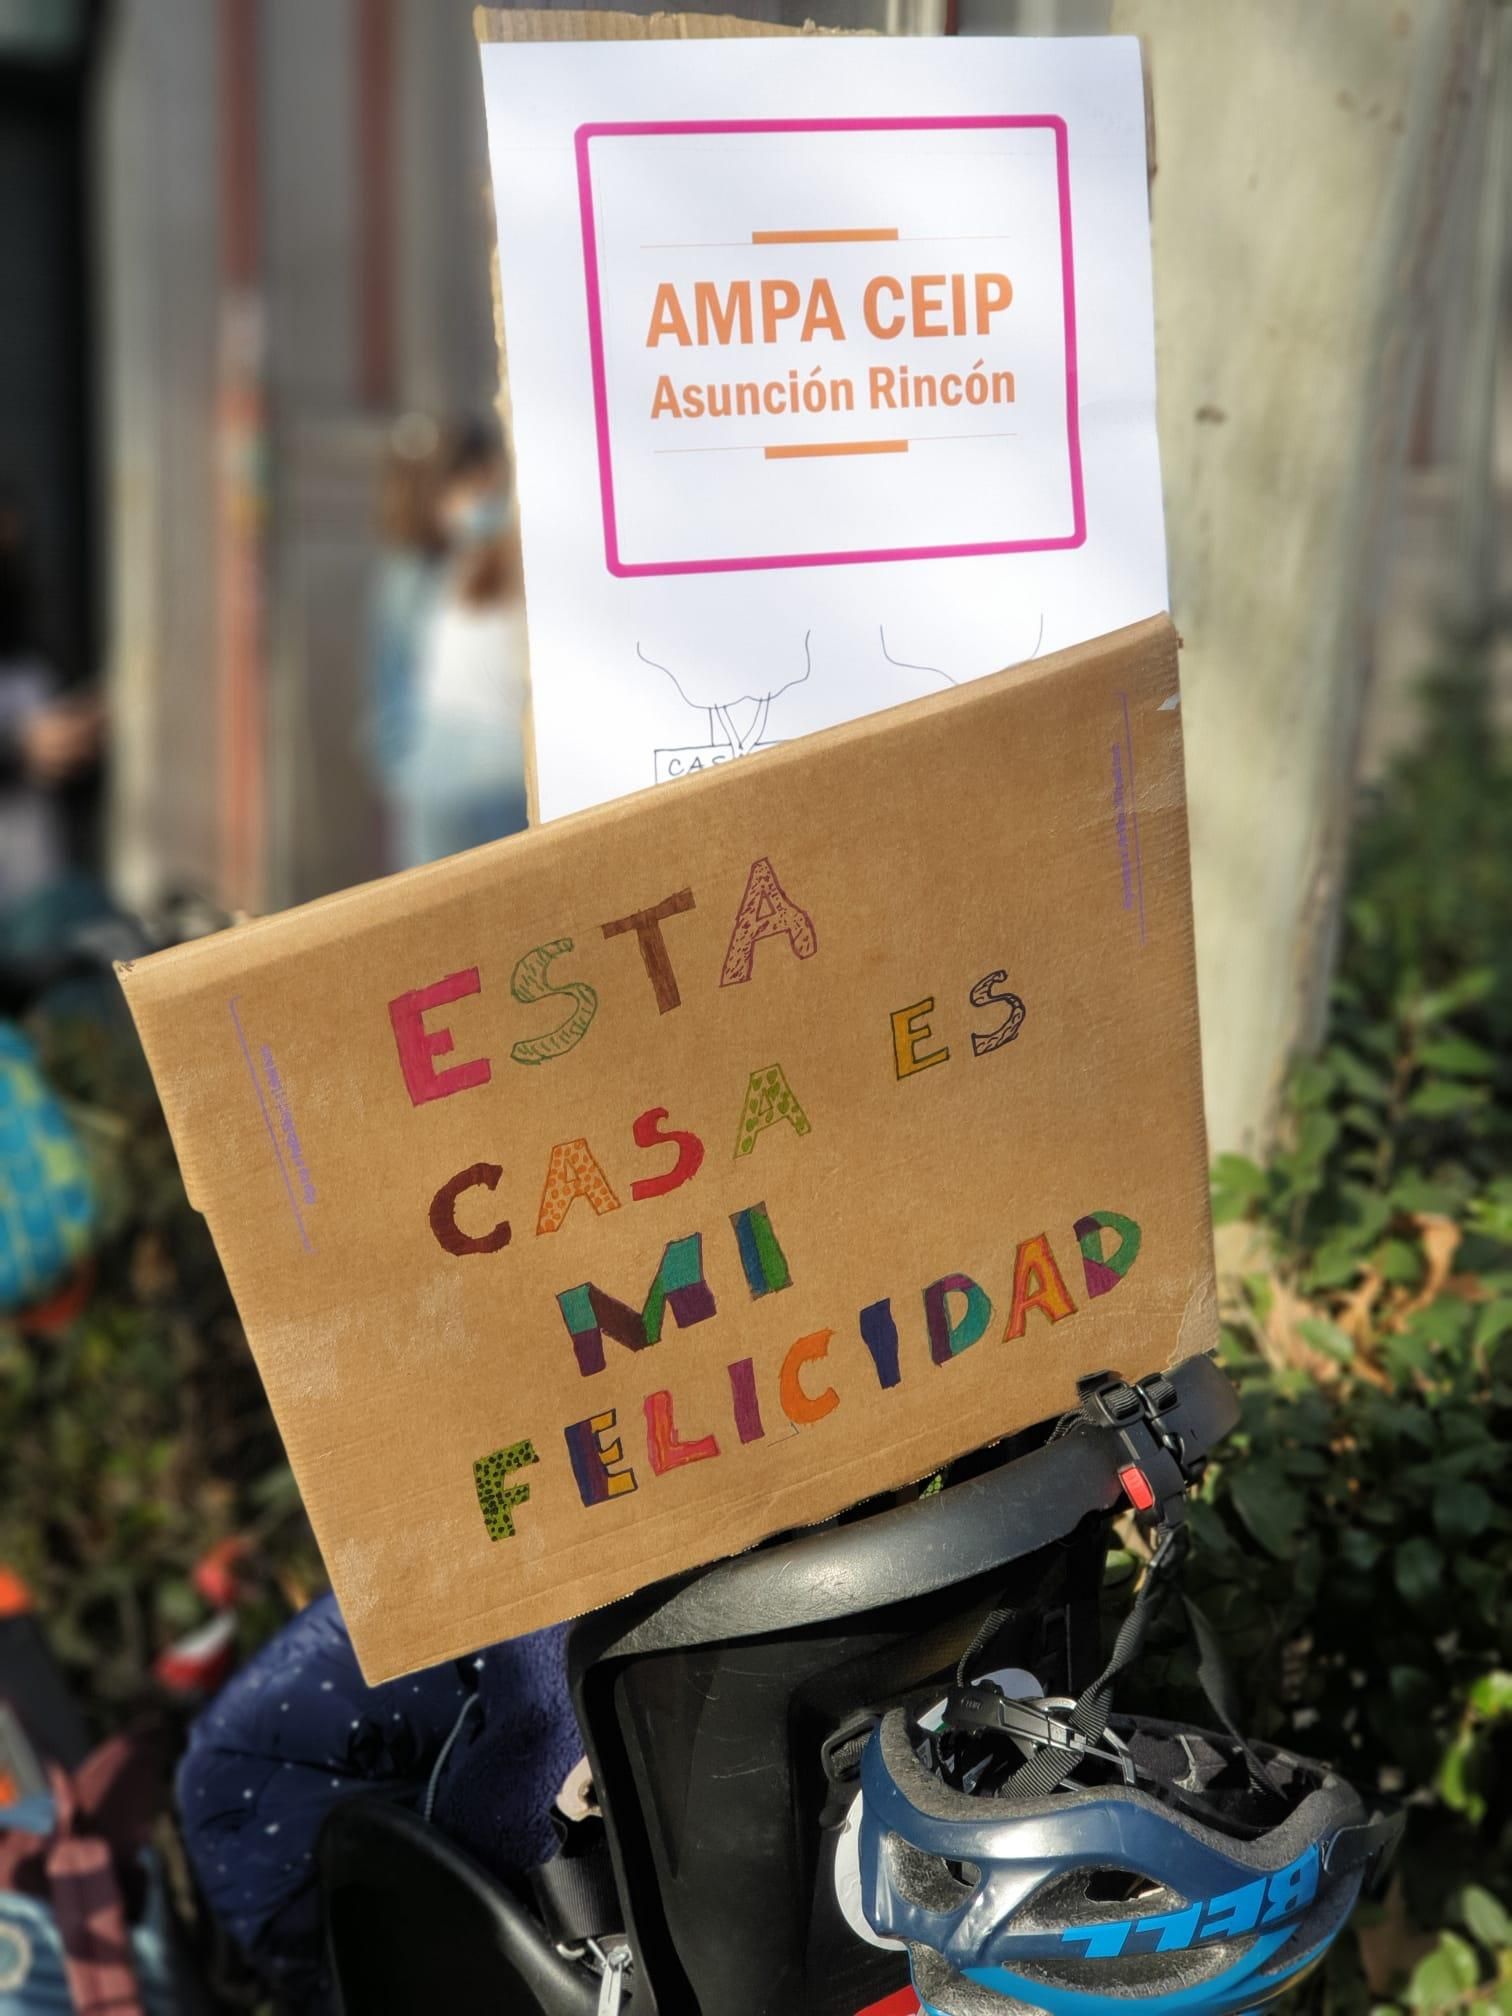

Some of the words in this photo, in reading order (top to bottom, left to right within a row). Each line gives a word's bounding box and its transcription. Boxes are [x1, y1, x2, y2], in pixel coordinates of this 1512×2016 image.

[645, 277, 846, 348] AMPA
[862, 272, 1014, 341] CEIP
[650, 366, 854, 420] Asunción
[869, 359, 1016, 410] Rincón
[387, 856, 818, 1108] ESTA
[429, 1063, 812, 1257] CASA
[890, 969, 1027, 1081] ES
[472, 1210, 1143, 1542] FELICIDAD
[555, 1201, 793, 1377] MI
[1061, 1842, 1320, 1959] BELL
